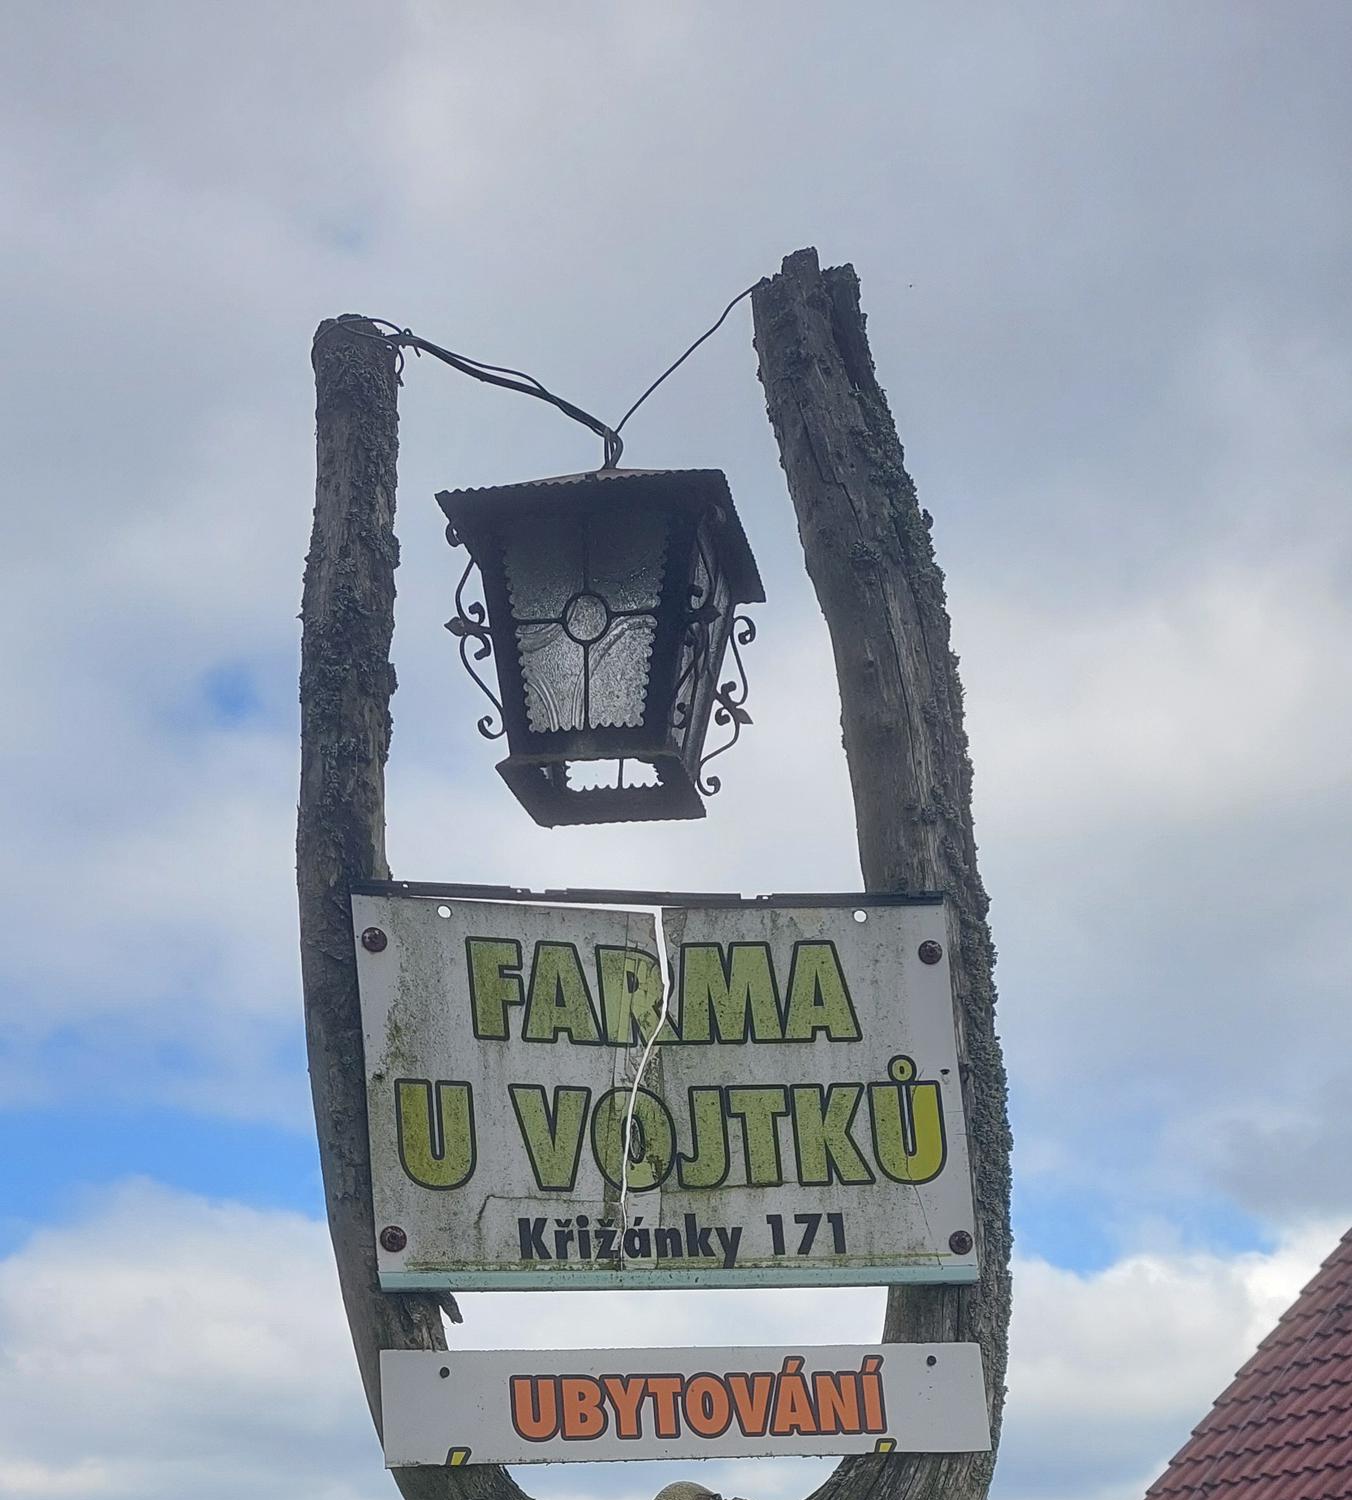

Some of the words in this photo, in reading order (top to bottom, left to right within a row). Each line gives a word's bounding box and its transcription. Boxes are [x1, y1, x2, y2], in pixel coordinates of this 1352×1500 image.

[465, 937, 863, 1048] FARMA
[395, 1078, 477, 1190] U
[508, 1055, 947, 1192] VOJTKŮ
[517, 1215, 743, 1270] Křižánky
[767, 1213, 847, 1256] 171
[510, 1355, 887, 1442] UBYTOVÁNÍ
